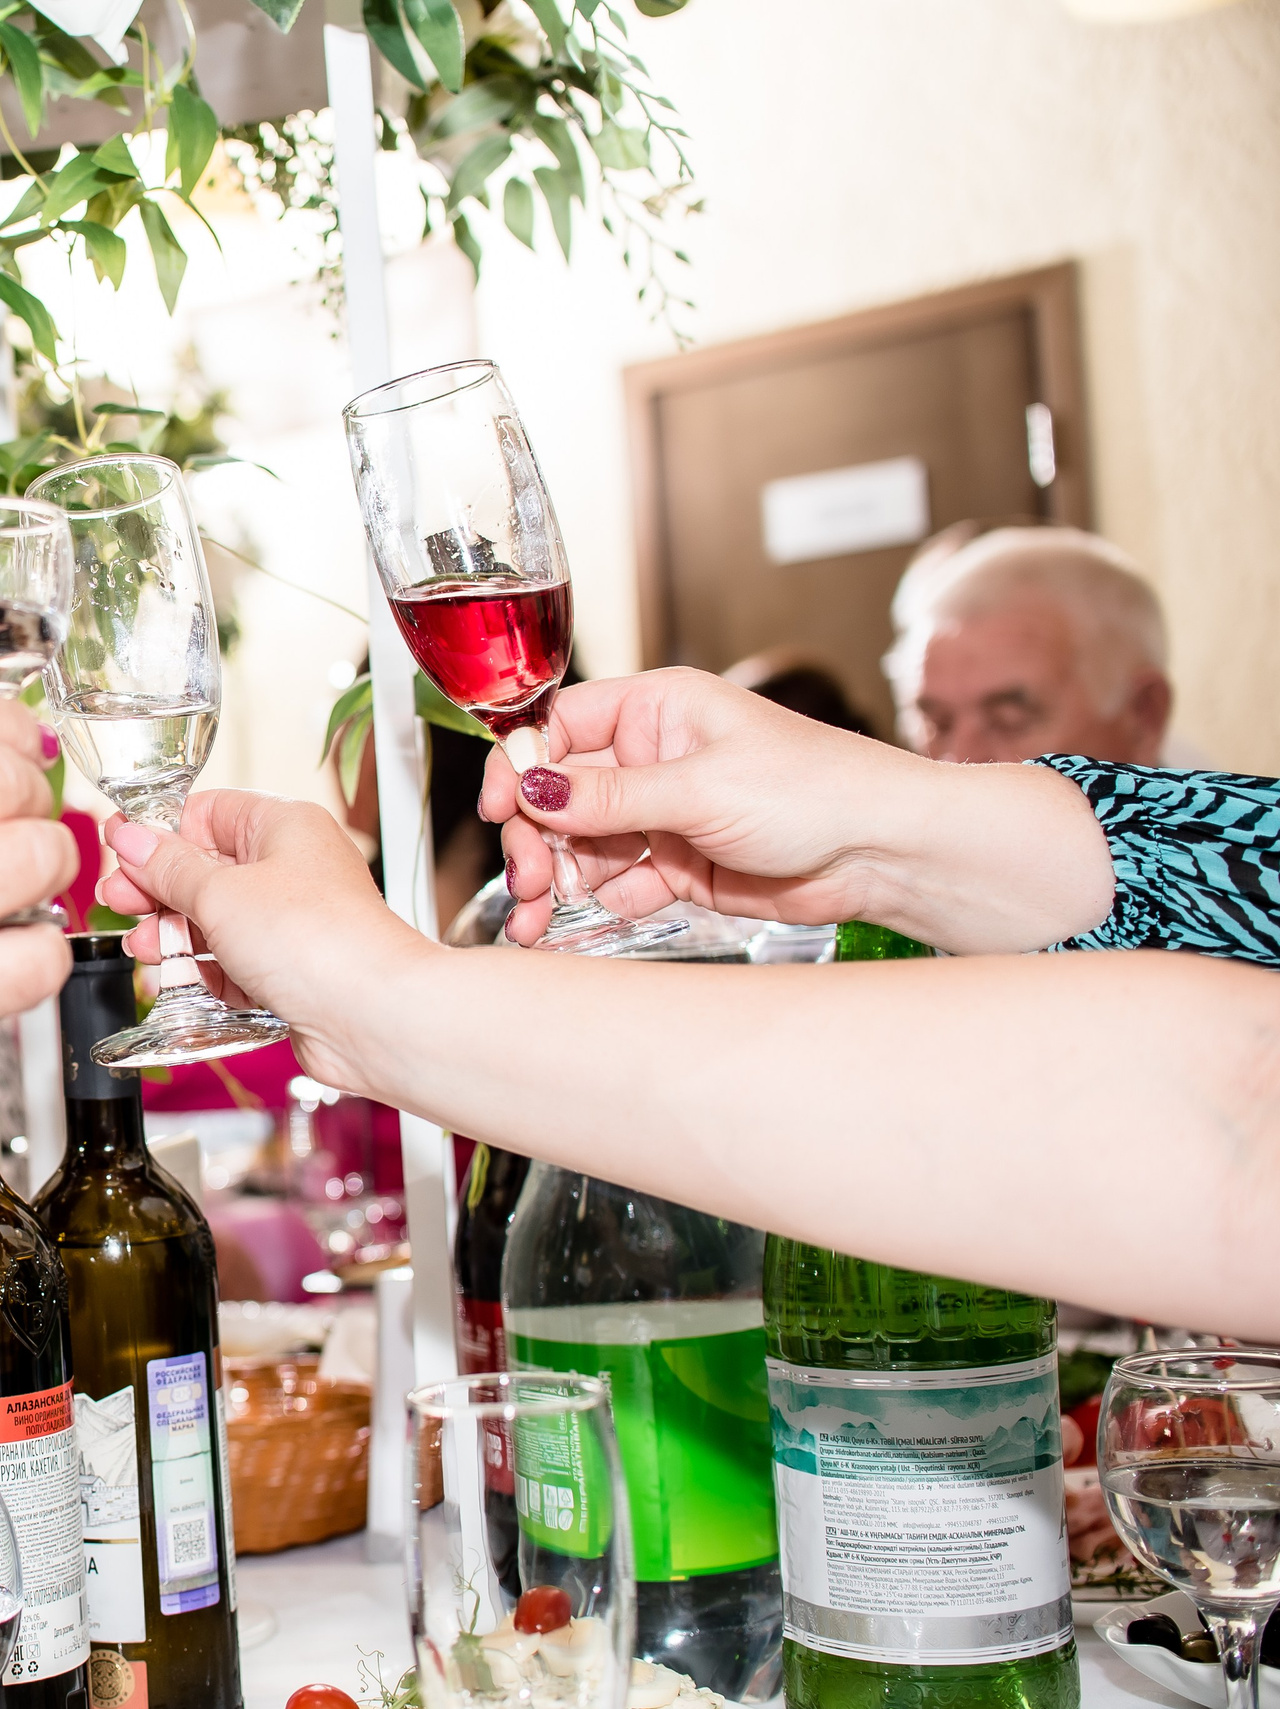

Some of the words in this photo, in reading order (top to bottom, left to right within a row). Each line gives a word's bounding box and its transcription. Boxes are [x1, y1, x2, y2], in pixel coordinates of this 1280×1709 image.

[6, 1392, 63, 1414] АЛАЗАНСКАЯ
[14, 1414, 34, 1426] ВИНО
[172, 1423, 194, 1431] МАРКА
[852, 1437, 865, 1445] Quyu
[851, 1462, 880, 1472] Krasnoqors
